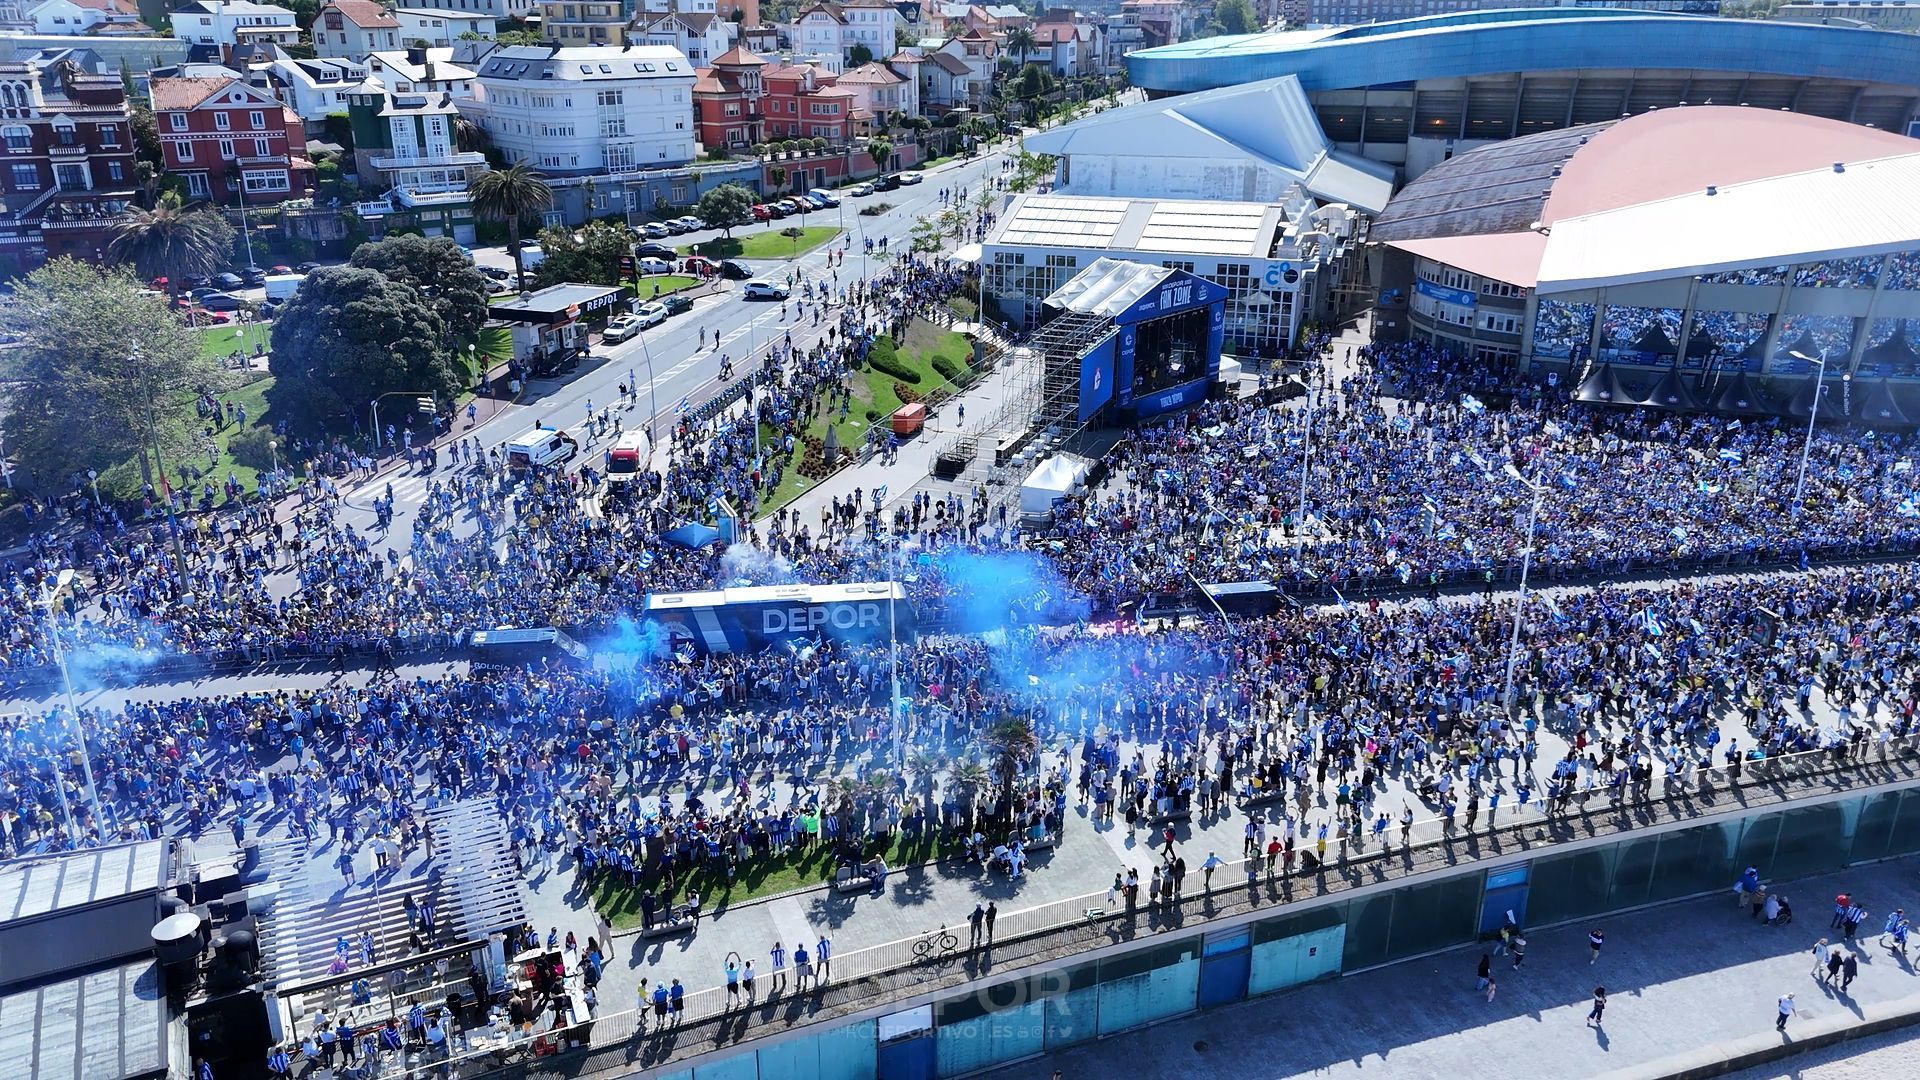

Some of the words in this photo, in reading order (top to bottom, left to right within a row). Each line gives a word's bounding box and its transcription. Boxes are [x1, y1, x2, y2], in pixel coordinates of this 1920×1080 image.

[586, 292, 618, 312] REPSOL
[1160, 289, 1172, 311] FAN
[1172, 285, 1193, 307] ZONE
[762, 602, 881, 634] DEPOR
